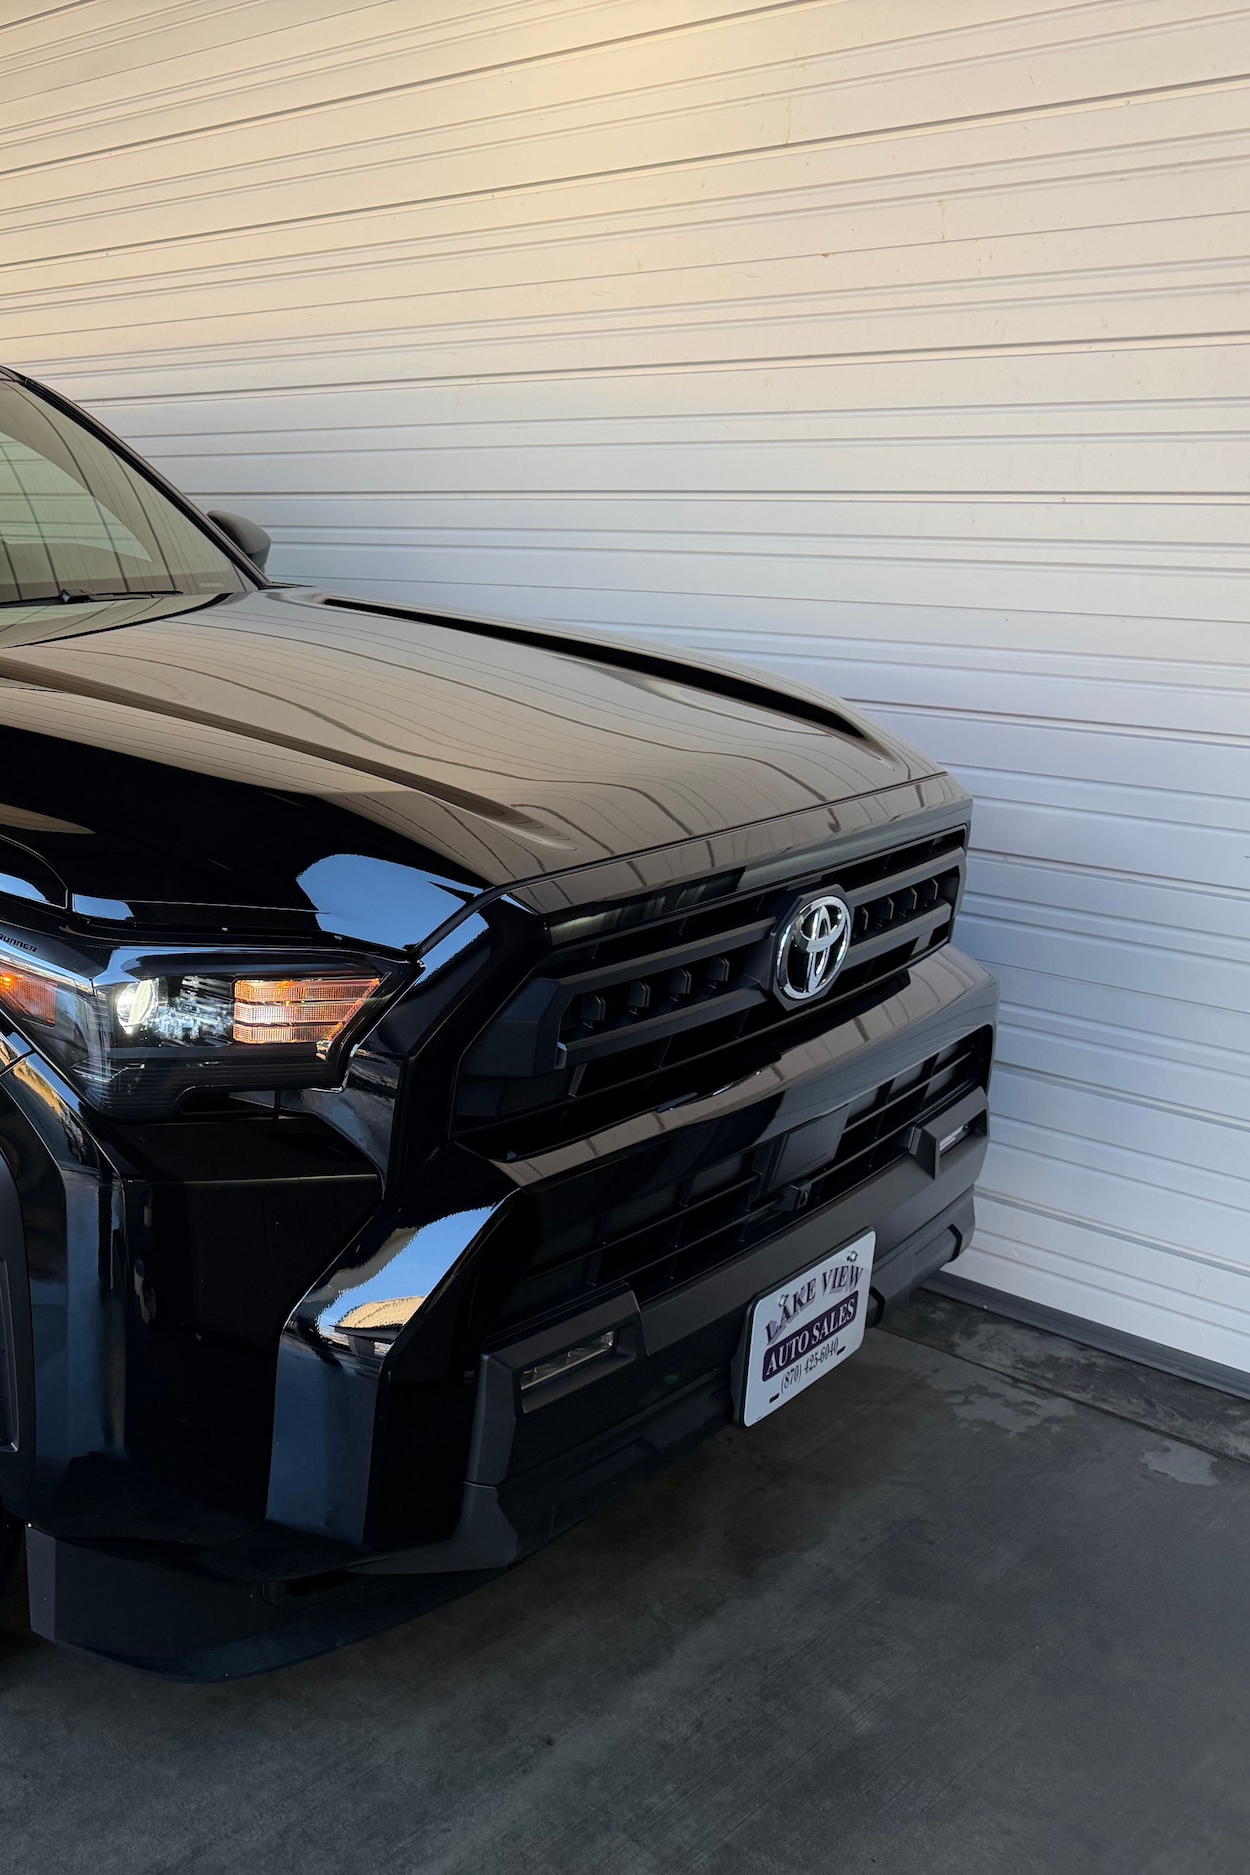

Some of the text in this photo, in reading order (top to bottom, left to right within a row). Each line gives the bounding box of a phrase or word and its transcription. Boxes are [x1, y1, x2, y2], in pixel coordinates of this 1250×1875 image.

[765, 1264, 865, 1345] LAKE VIEW
[765, 1298, 856, 1376] AUTO SALES
[780, 1337, 839, 1395] (870) 425-6040
